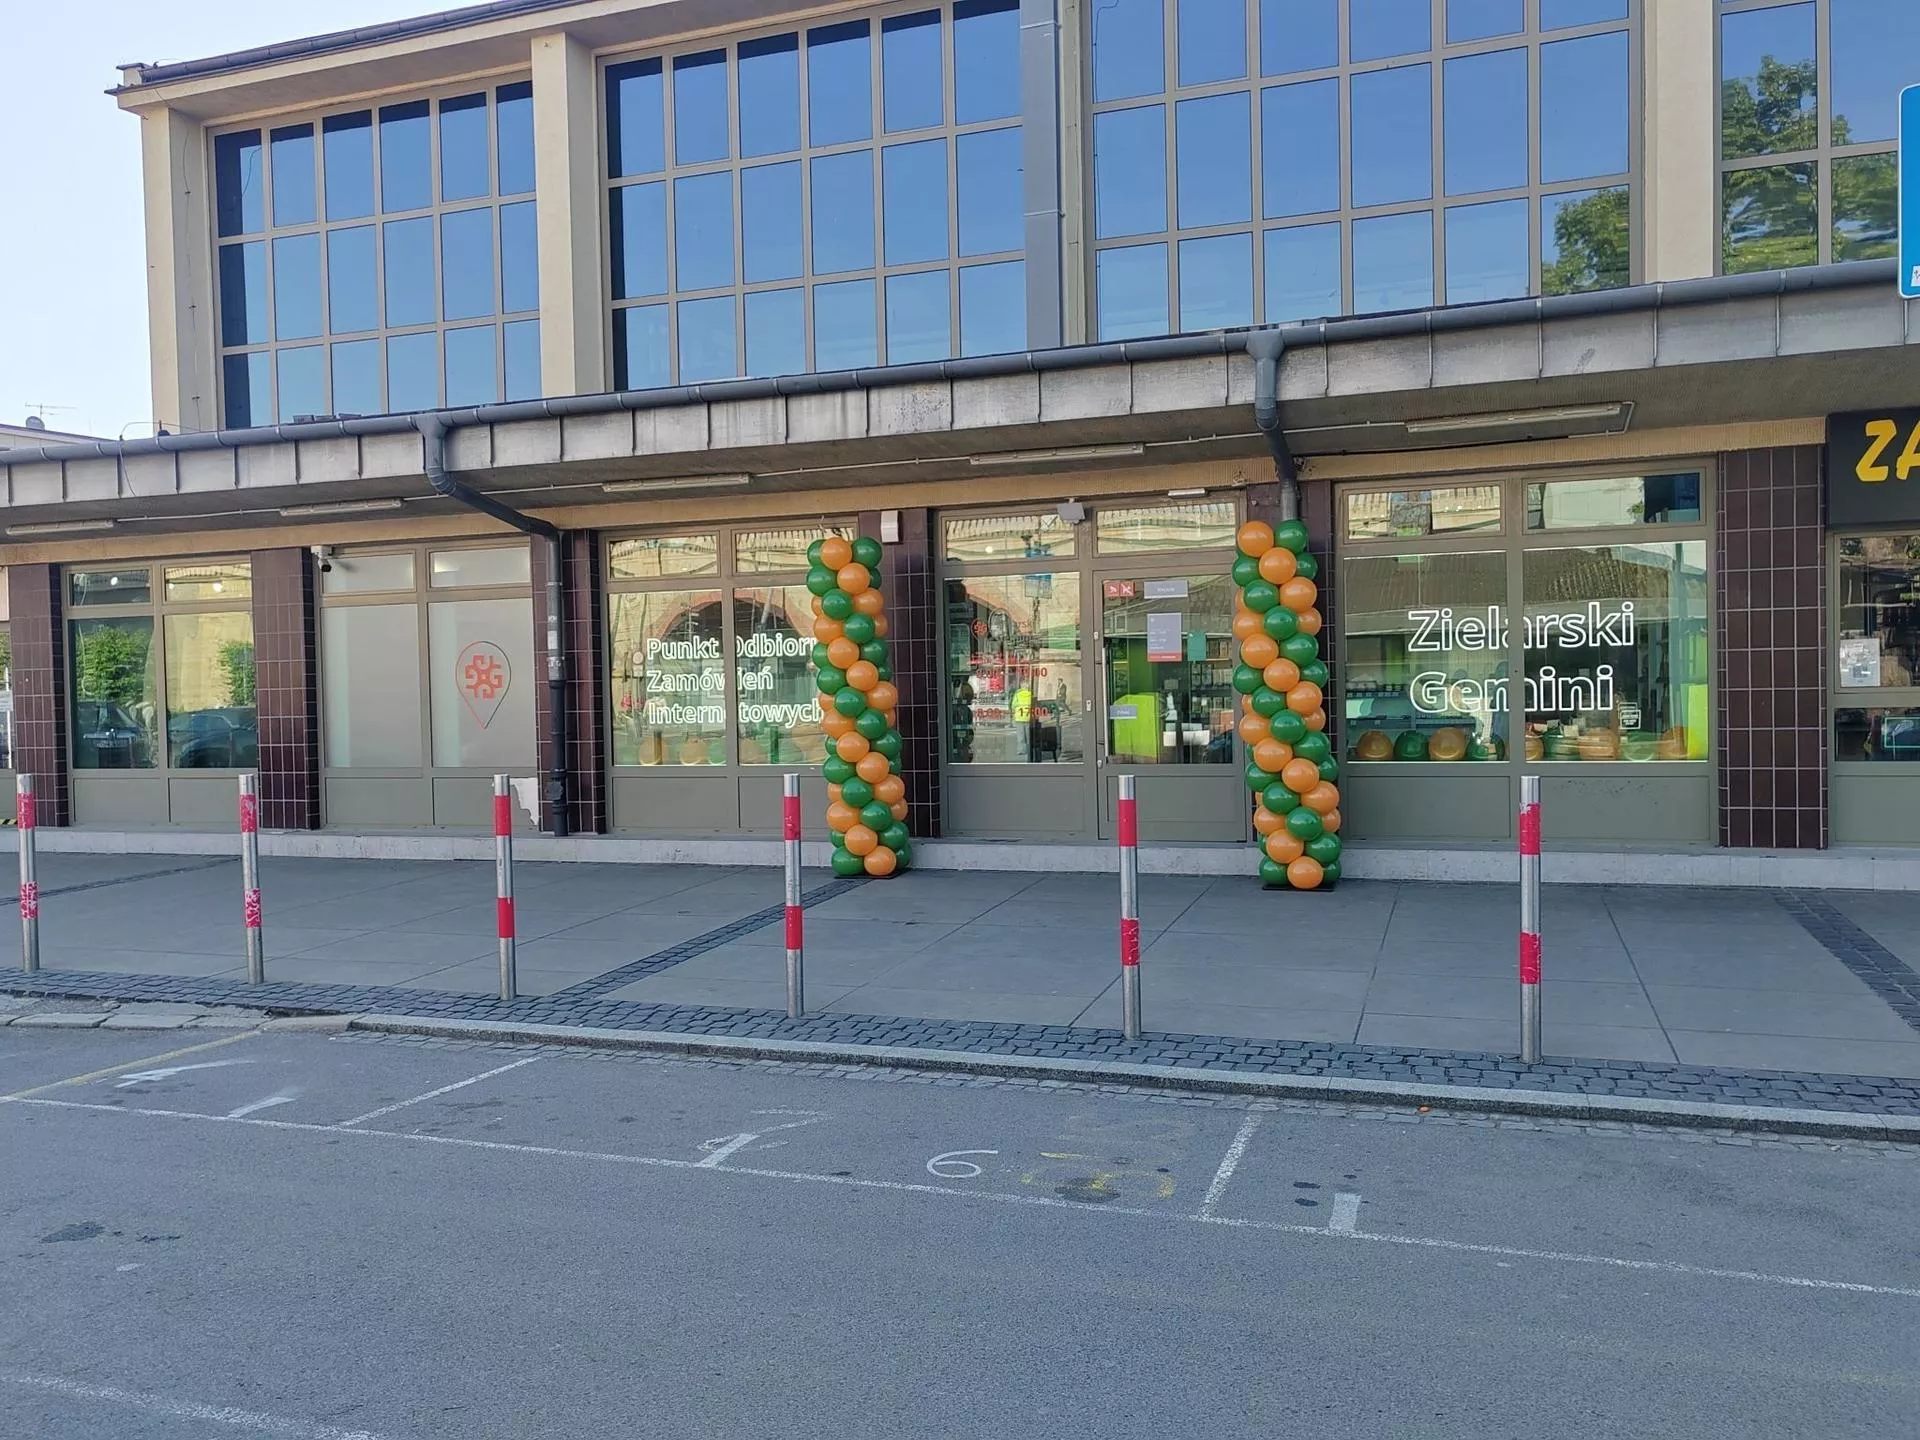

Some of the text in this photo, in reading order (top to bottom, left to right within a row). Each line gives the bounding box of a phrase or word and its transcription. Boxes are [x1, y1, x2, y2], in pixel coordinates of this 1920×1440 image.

[647, 636, 719, 660] Punkt
[1410, 666, 1613, 713] Gemini
[649, 698, 824, 728] Interntowych
[926, 1149, 998, 1178] 6
